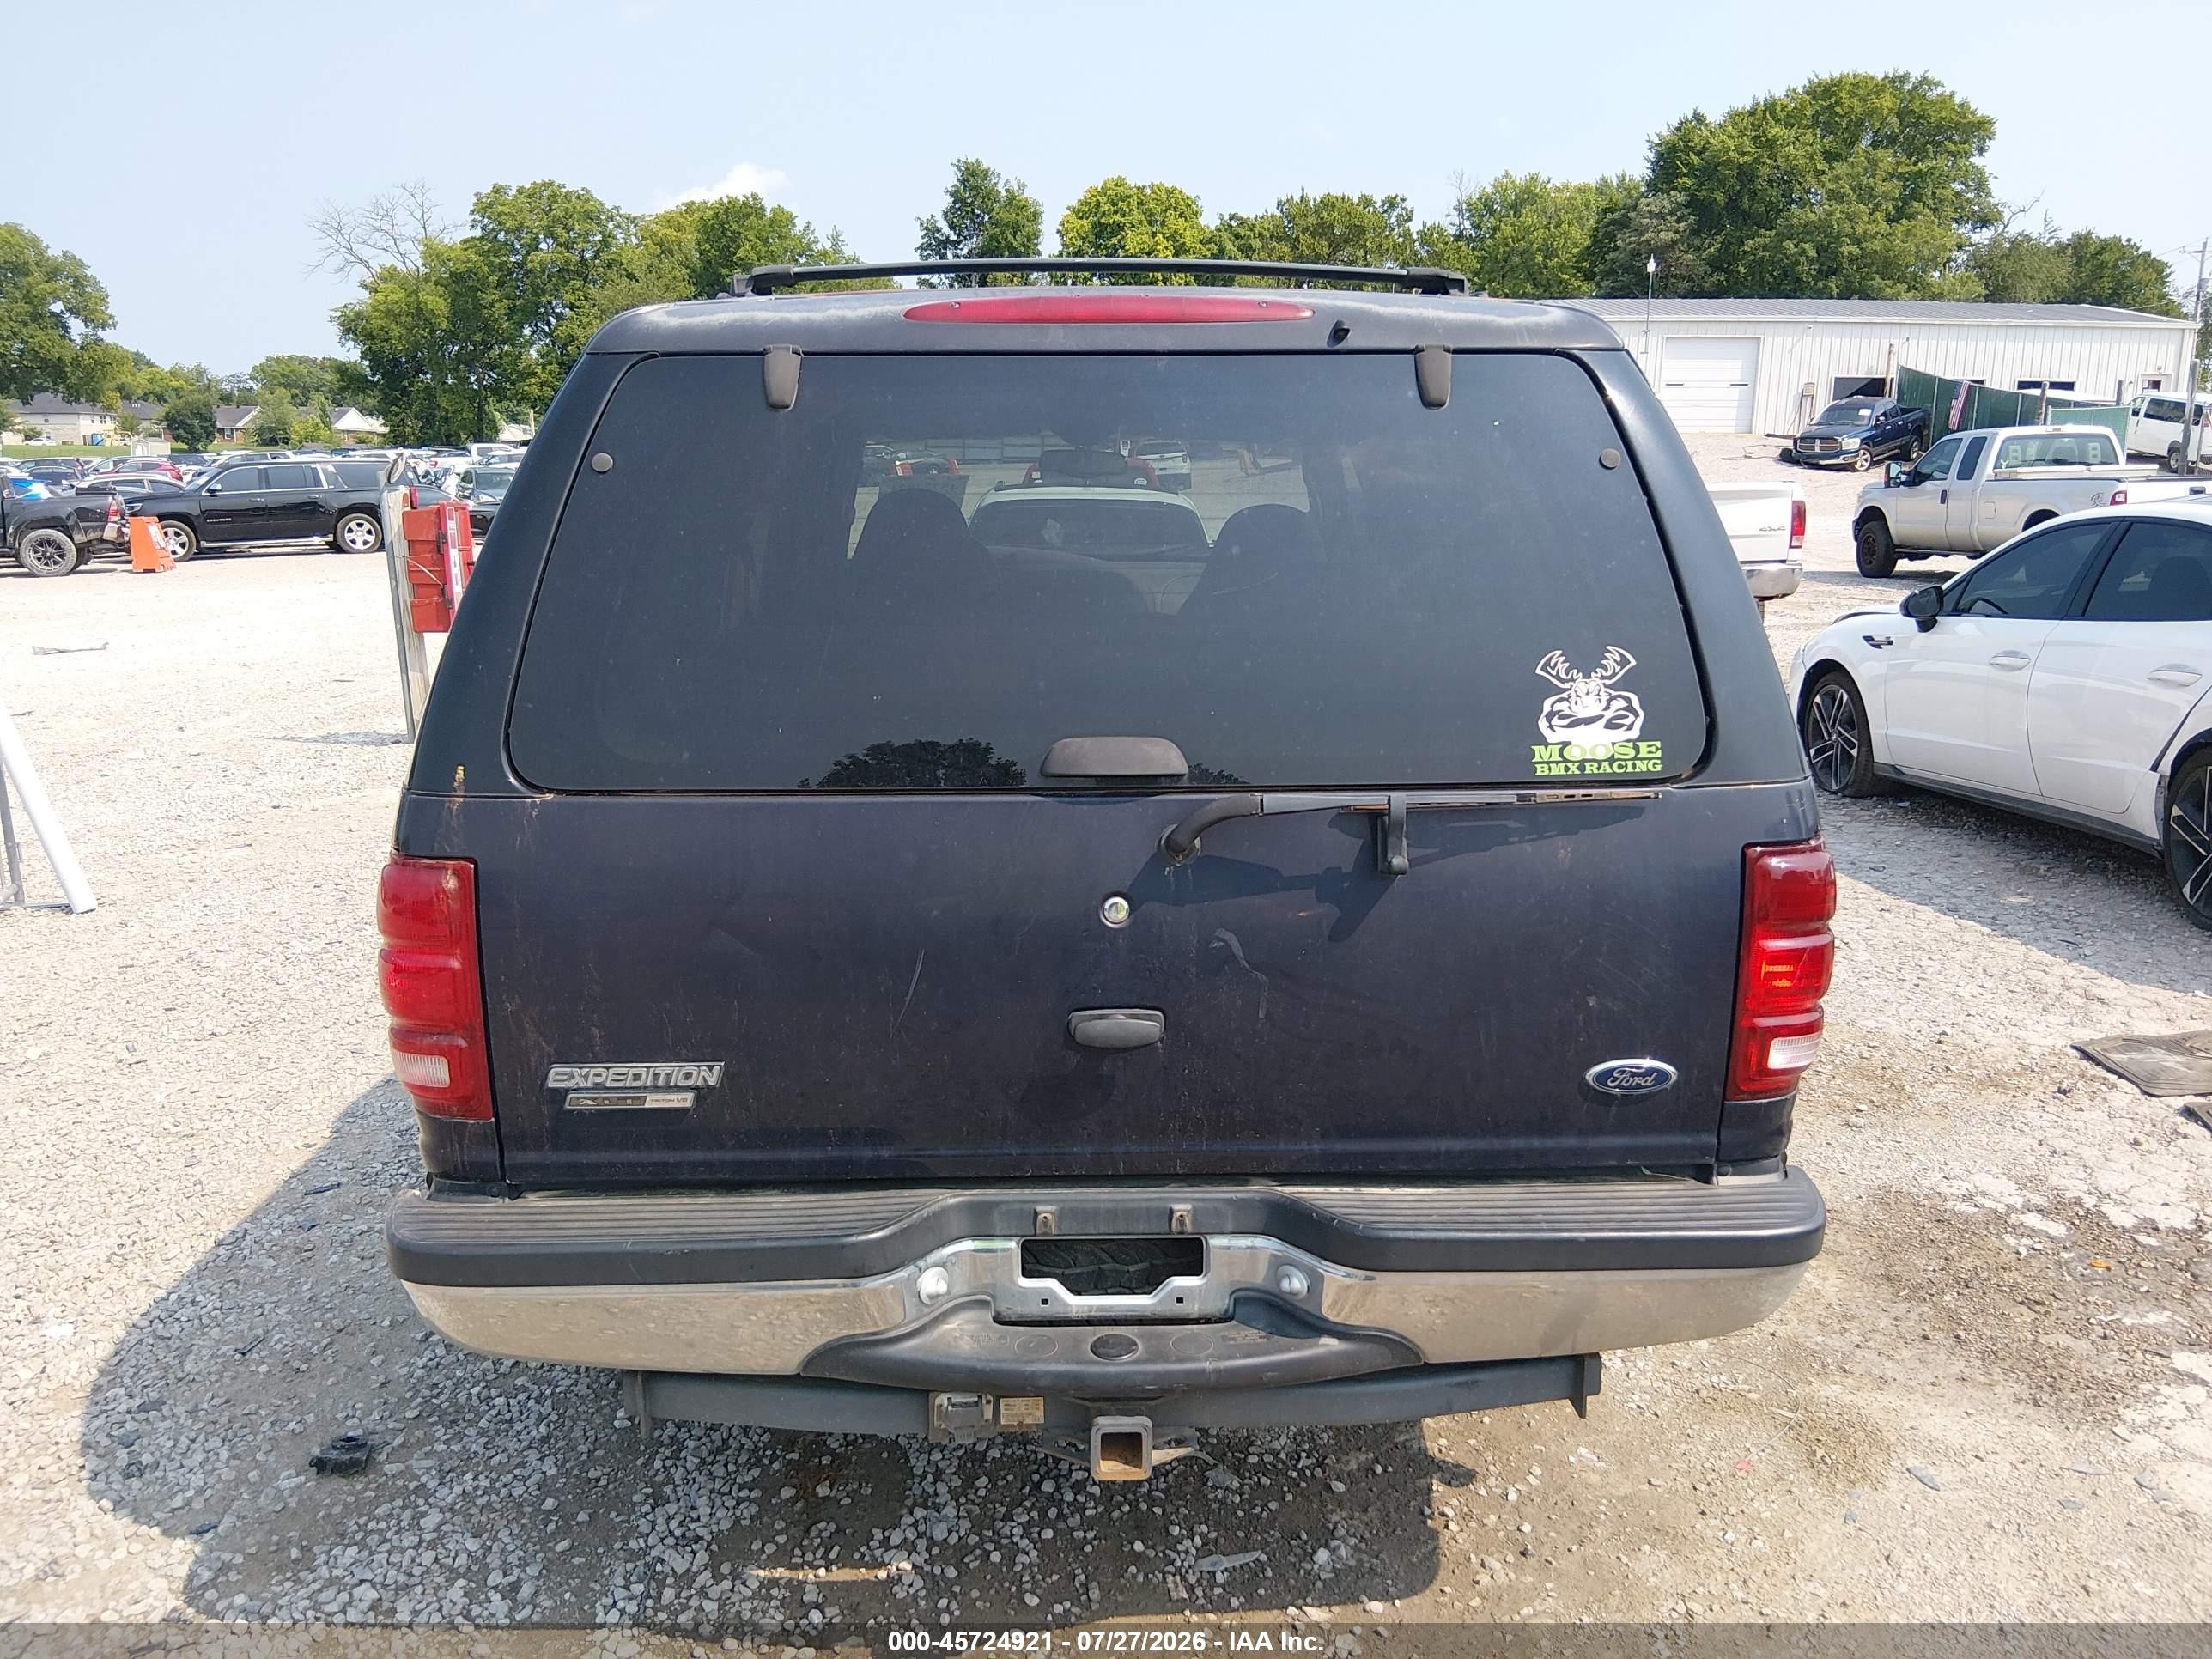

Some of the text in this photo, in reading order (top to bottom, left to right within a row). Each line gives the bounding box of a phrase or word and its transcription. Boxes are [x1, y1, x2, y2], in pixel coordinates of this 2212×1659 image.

[1531, 741, 1662, 763] MOOSE
[1534, 759, 1663, 776] BMX RACING
[548, 1065, 723, 1088] EXPEDITION
[1607, 1067, 1658, 1087] Ford
